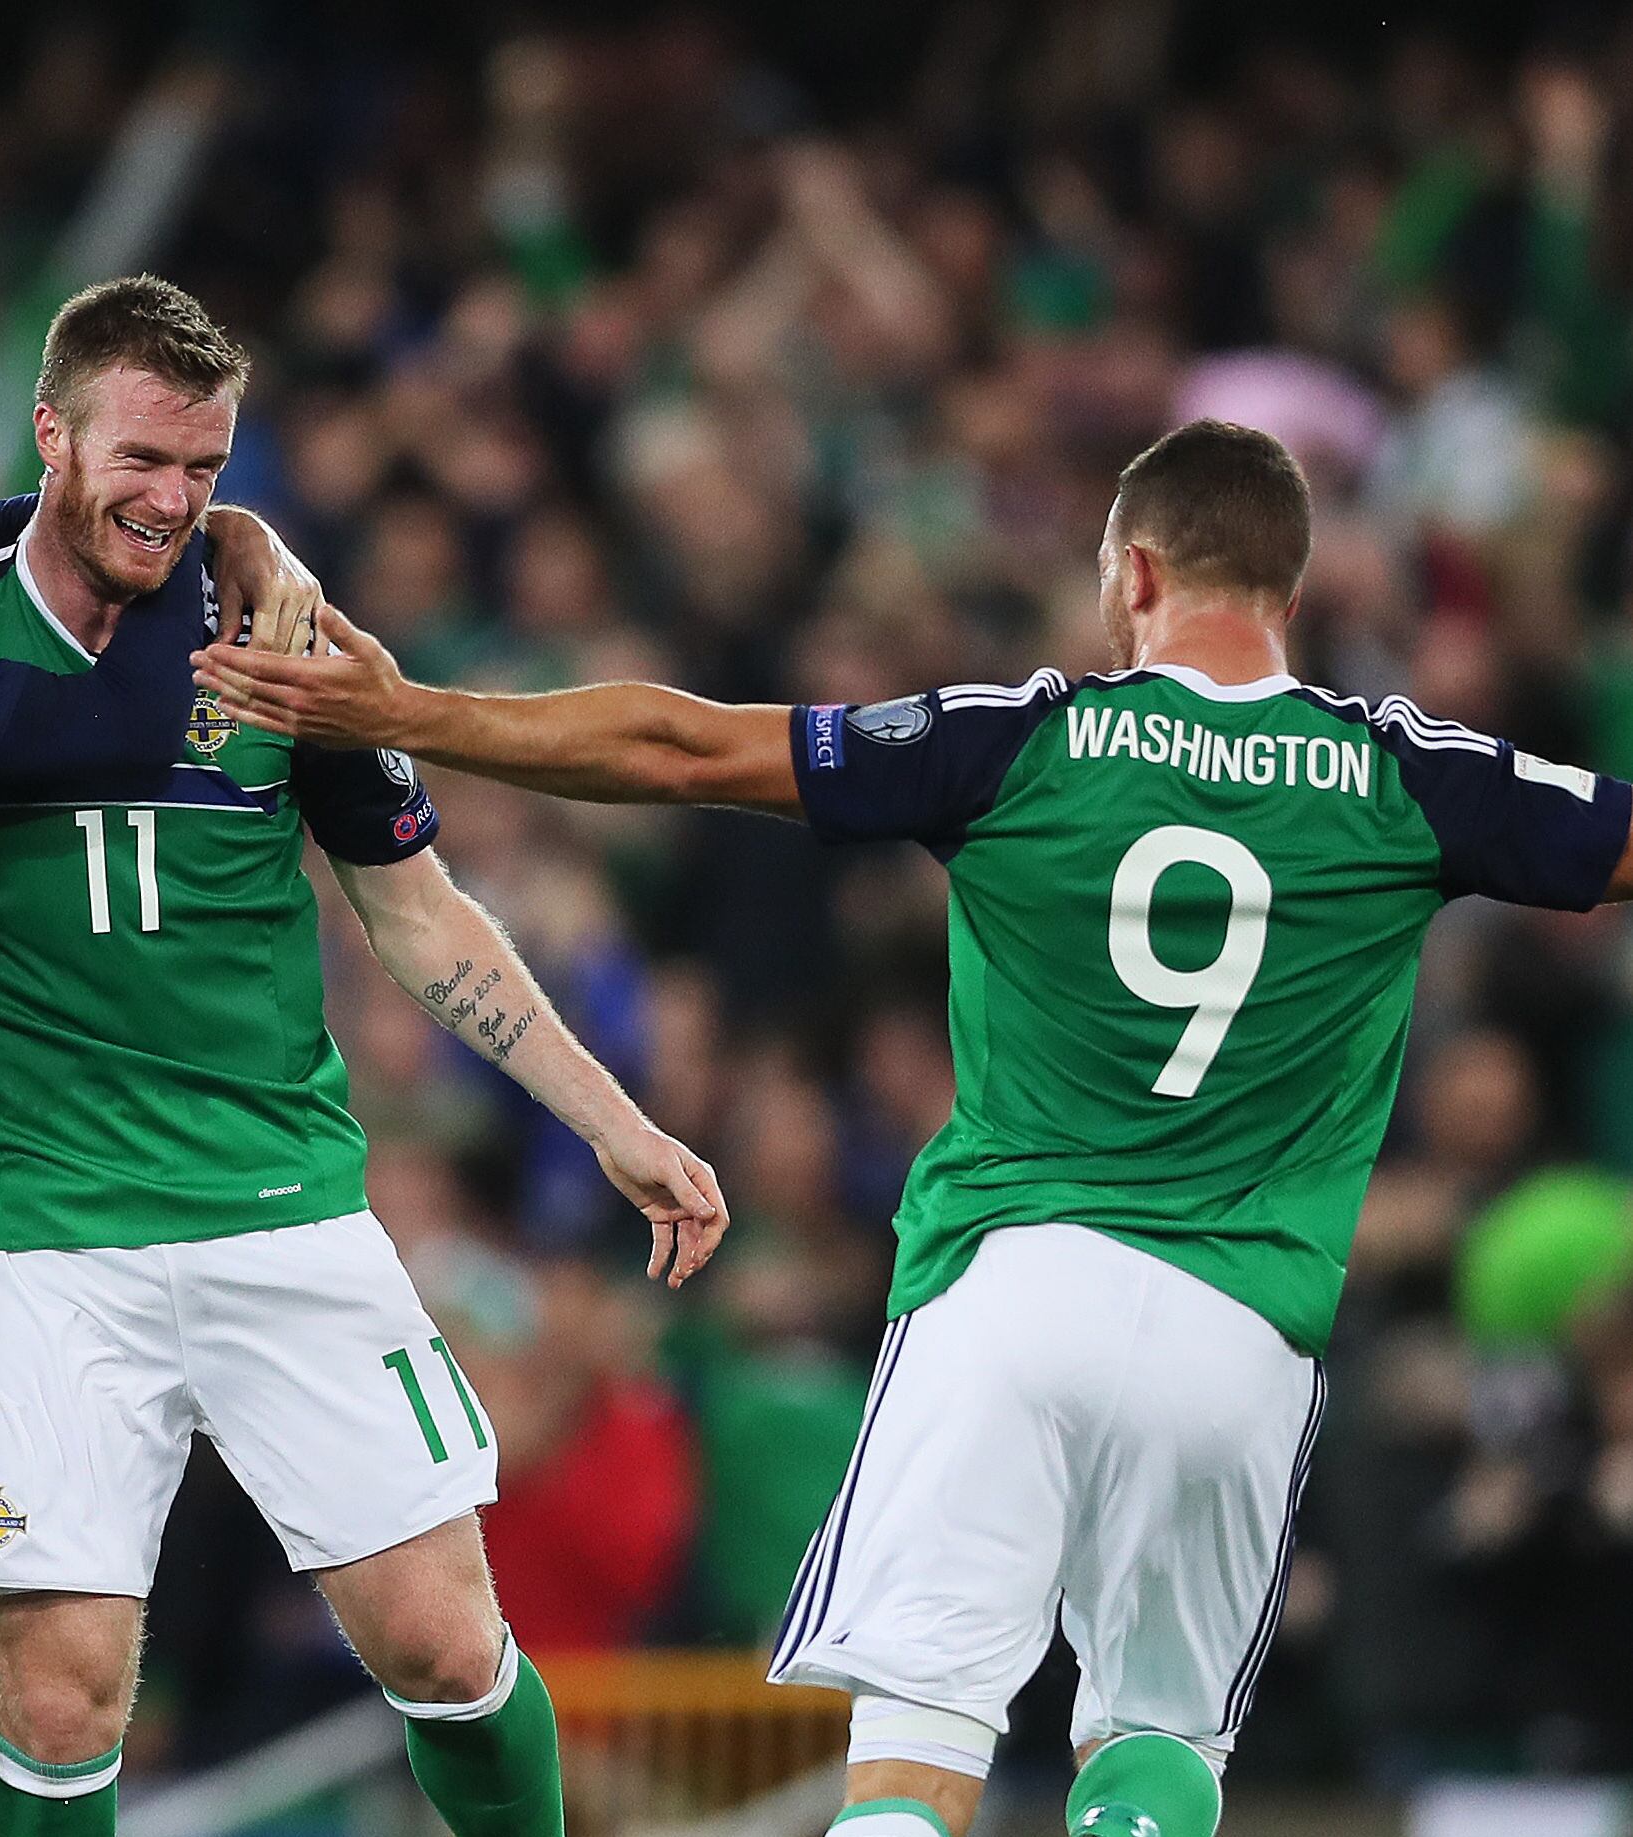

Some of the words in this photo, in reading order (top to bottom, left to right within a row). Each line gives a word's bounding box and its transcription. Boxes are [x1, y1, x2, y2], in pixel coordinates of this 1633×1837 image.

[1066, 706, 1371, 799] WASHINGTON
[74, 809, 160, 934] 11
[424, 959, 473, 1005] Charlie
[474, 968, 502, 1000] 2008
[1107, 824, 1273, 1099] 9
[513, 1006, 538, 1038] 2011
[258, 1182, 302, 1199] climacool
[382, 1336, 488, 1464] 11
